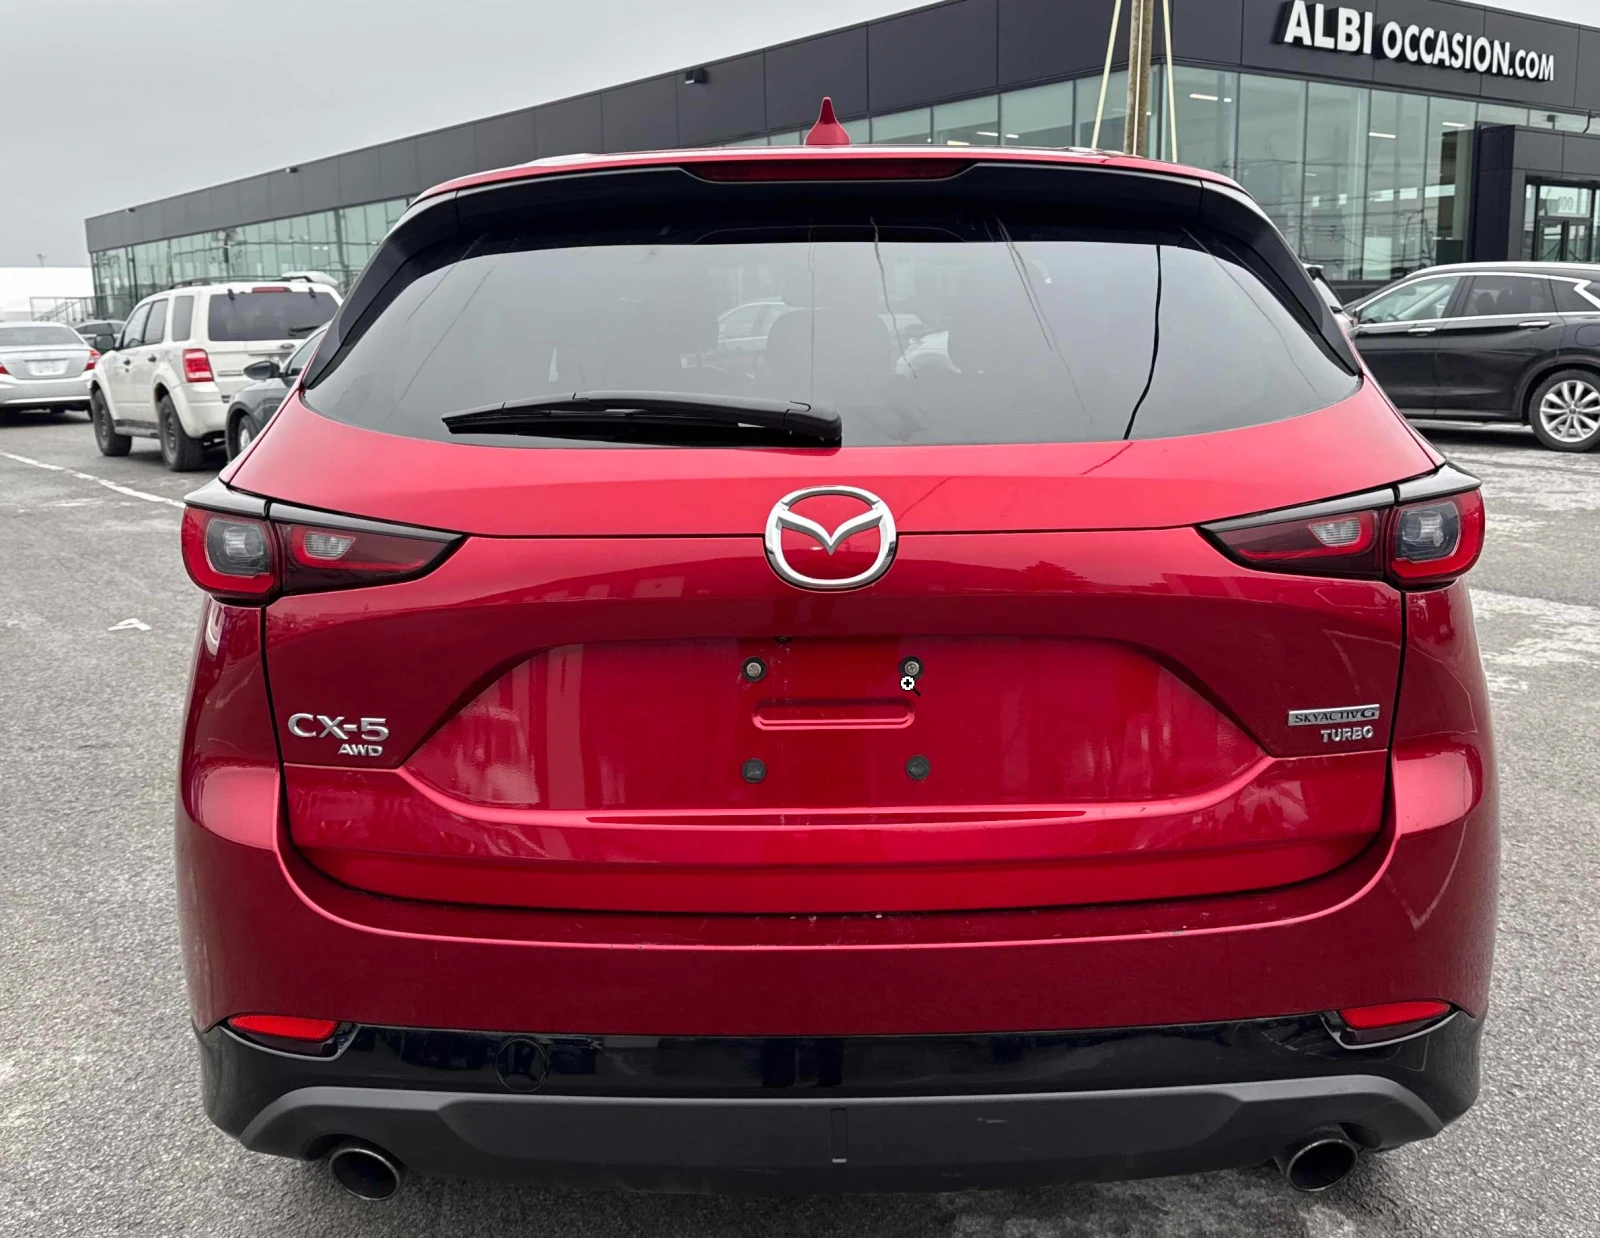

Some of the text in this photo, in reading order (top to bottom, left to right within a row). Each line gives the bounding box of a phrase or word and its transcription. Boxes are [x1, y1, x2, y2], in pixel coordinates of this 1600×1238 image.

[1283, 0, 1555, 81] ALBI OCCASION.COM
[287, 712, 390, 741] CX-5
[1320, 725, 1374, 743] TURBO
[337, 743, 383, 756] AWD
